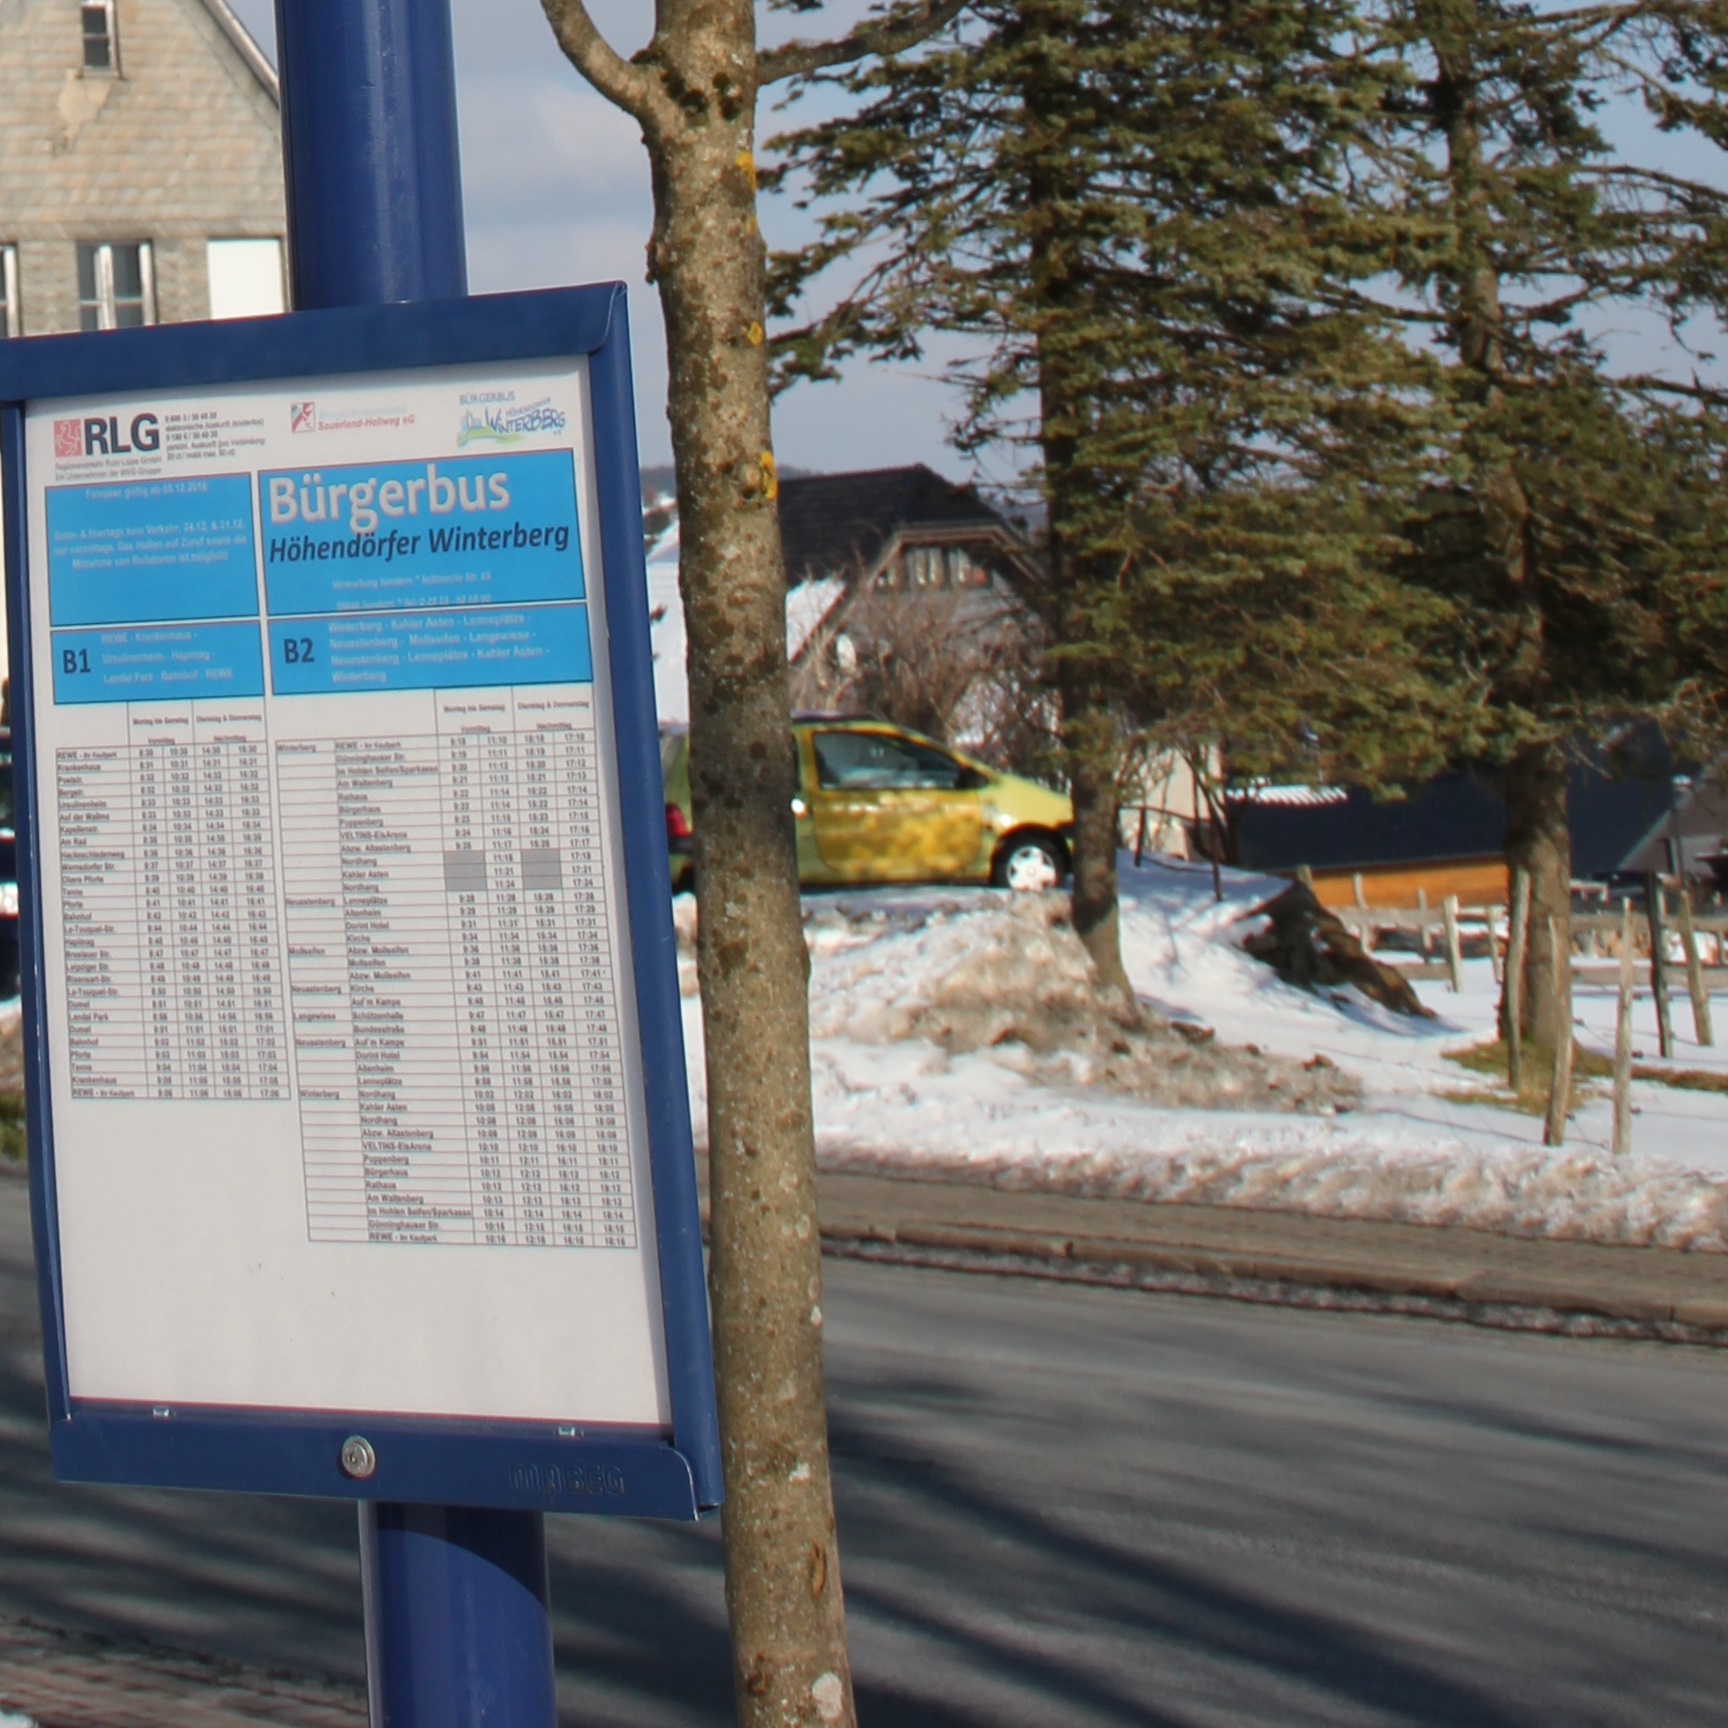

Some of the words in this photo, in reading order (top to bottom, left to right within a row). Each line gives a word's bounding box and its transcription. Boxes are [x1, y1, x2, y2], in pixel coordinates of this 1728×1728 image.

[84, 413, 160, 455] RLG
[486, 408, 566, 434] WINTERBERG
[269, 463, 510, 534] Bürgerbus
[270, 529, 420, 562] Höhendörfer
[429, 522, 569, 553] Winterberg
[63, 649, 91, 673] B1
[283, 638, 314, 664] B2
